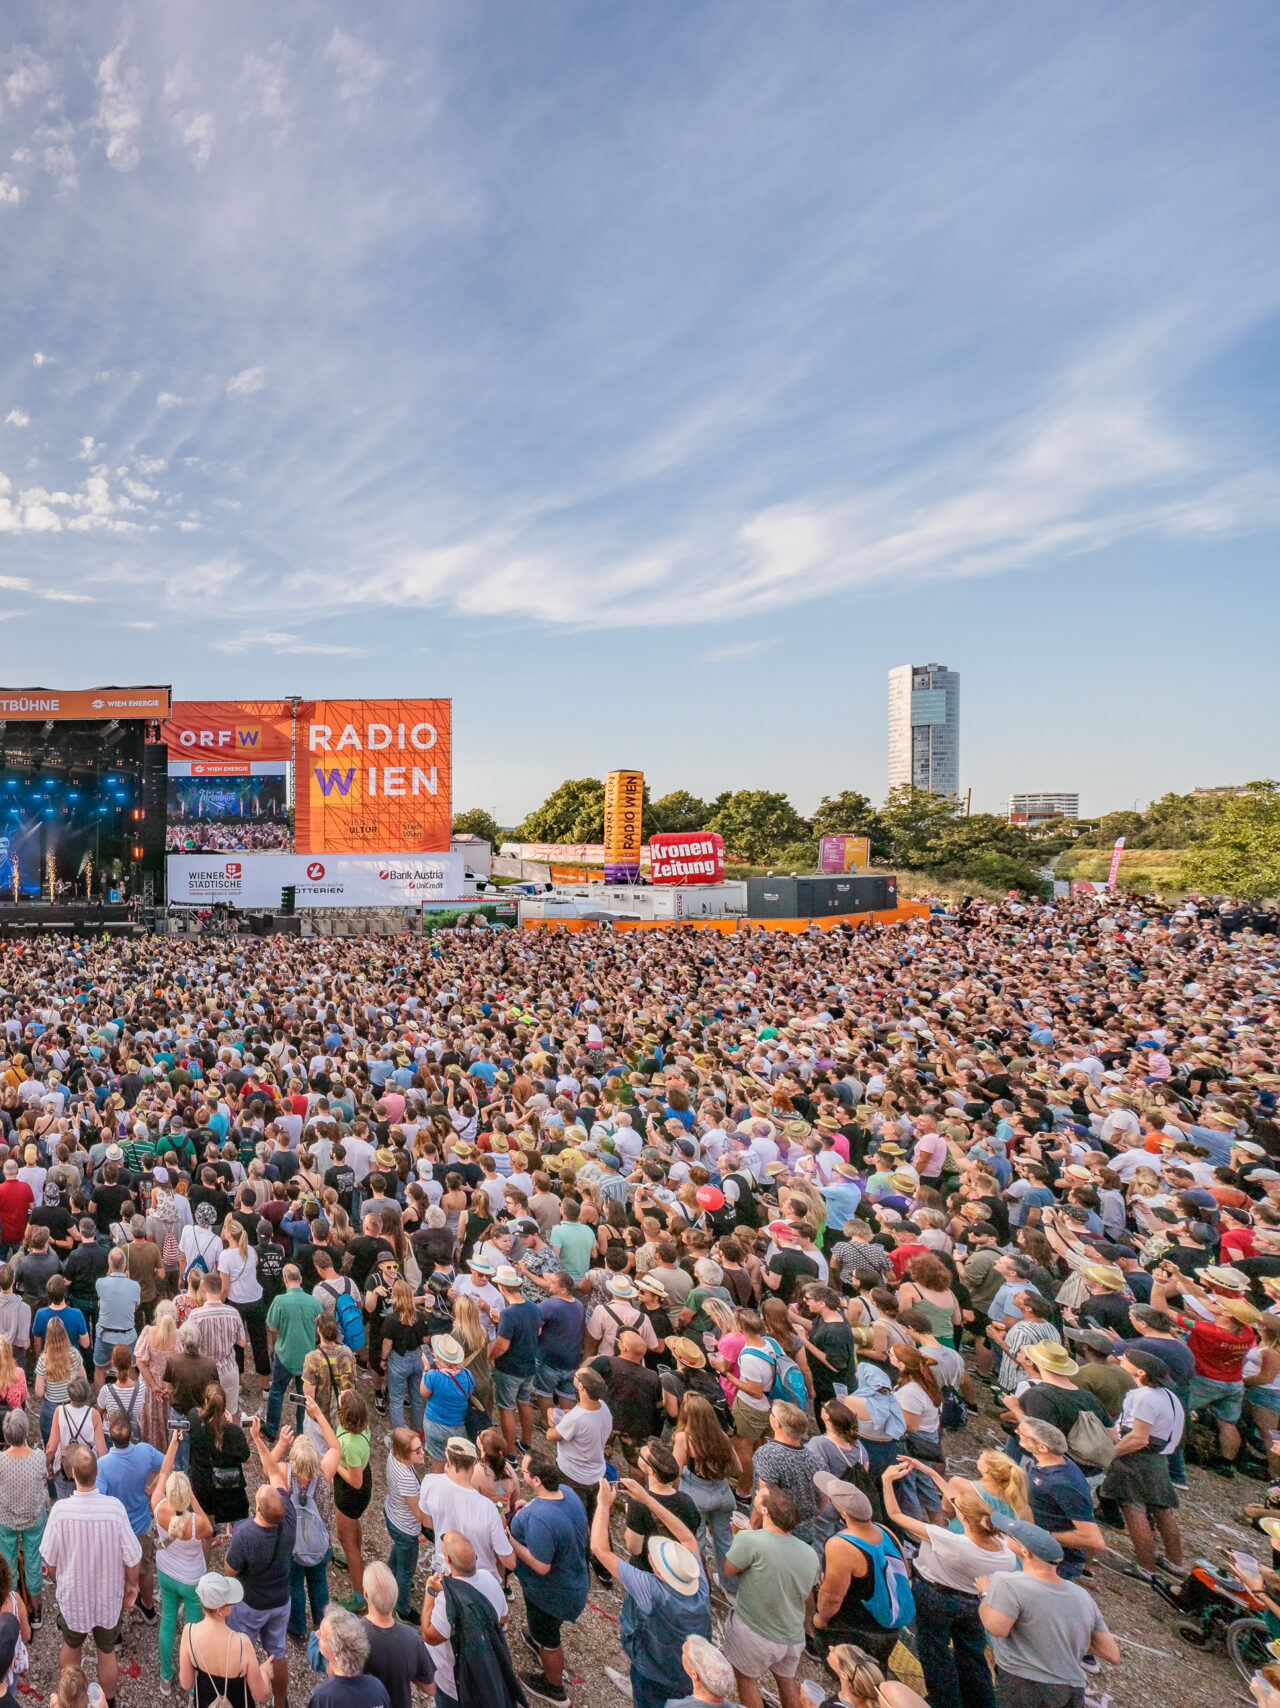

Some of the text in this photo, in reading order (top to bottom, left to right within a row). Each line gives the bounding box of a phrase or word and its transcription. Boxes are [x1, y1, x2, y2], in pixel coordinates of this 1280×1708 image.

[180, 730, 232, 747] ORF
[308, 722, 438, 751] RADIO
[624, 776, 637, 850] RADIO WIEN
[650, 841, 714, 860] Kronen
[188, 872, 224, 880] WIENER
[390, 870, 444, 880] Bank Austria
[652, 860, 715, 878] Zeitung
